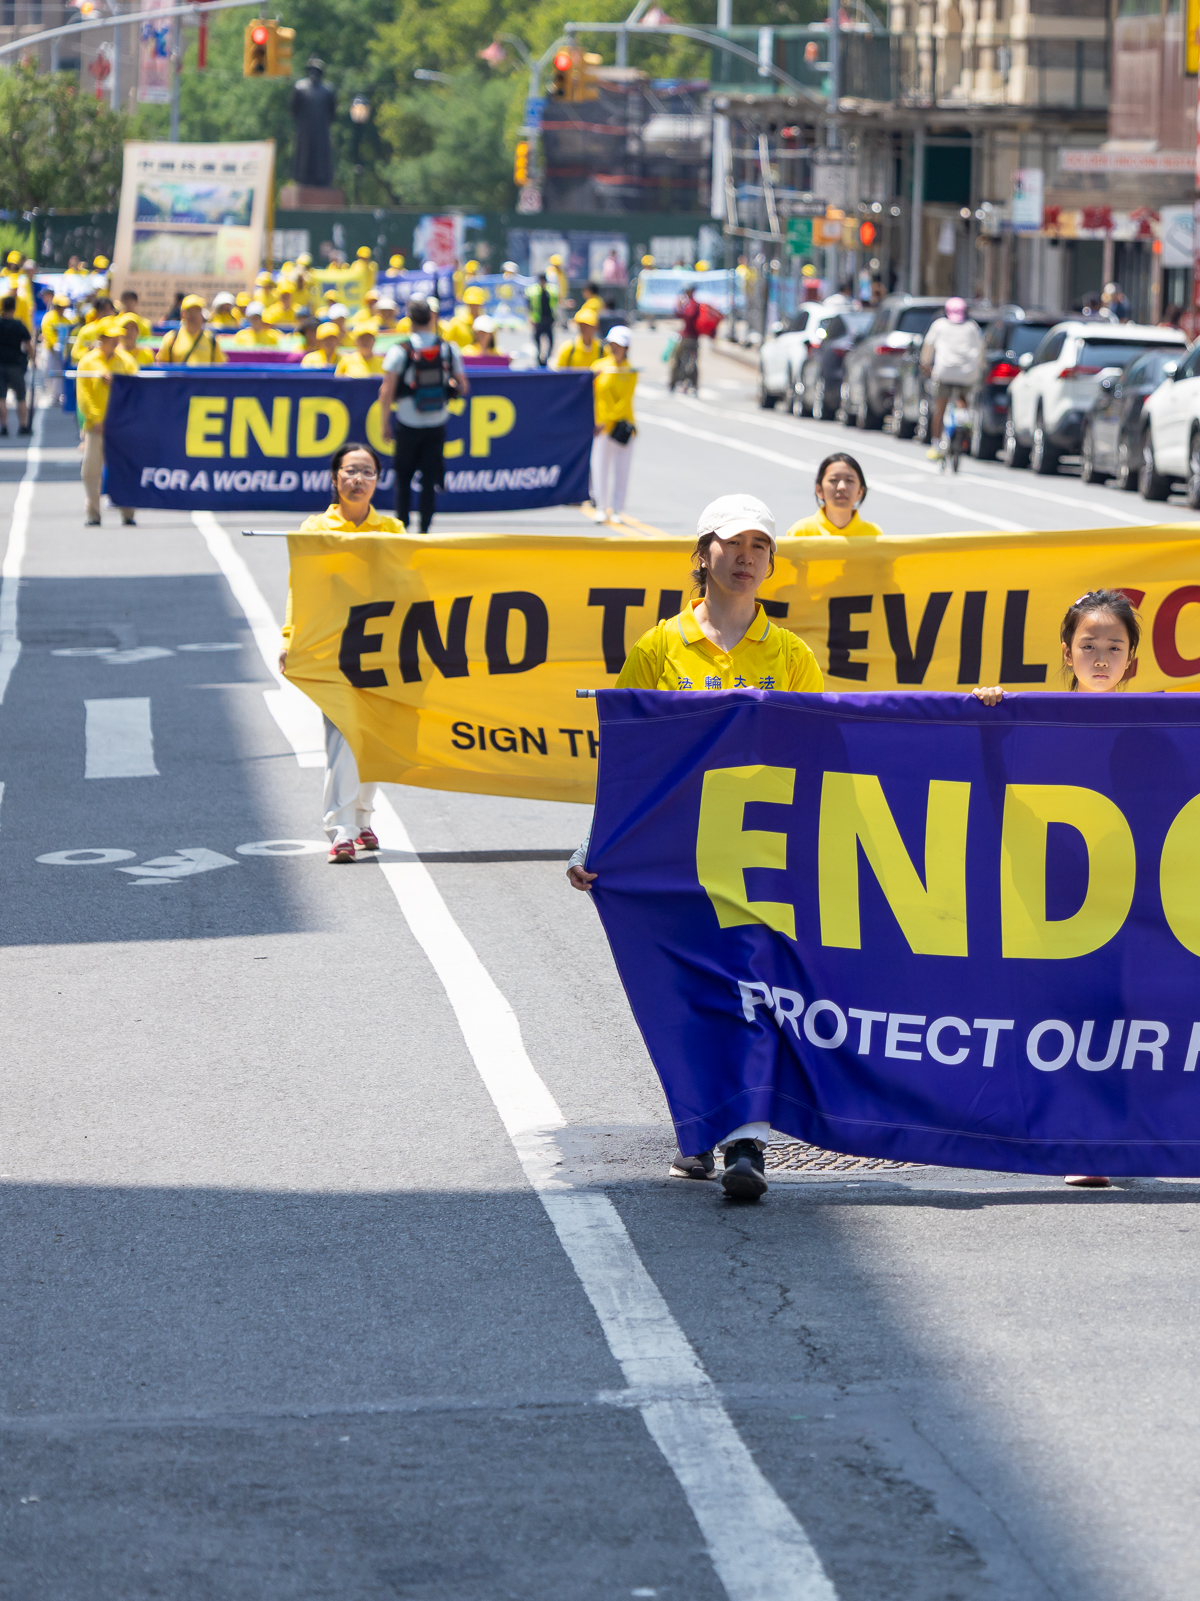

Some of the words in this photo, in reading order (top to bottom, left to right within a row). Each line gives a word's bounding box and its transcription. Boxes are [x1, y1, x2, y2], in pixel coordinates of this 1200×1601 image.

[185, 396, 350, 458] END
[141, 467, 189, 491] FOR
[190, 470, 209, 491] A
[213, 470, 300, 491] WORLD
[410, 465, 561, 492] CMMUNISM
[338, 591, 549, 688] END
[826, 590, 1048, 685] EVIL
[677, 675, 776, 690] 法輪大法
[451, 721, 548, 756] SIGN
[737, 980, 1015, 1068] PROTECT
[1026, 1019, 1170, 1072] OUR
